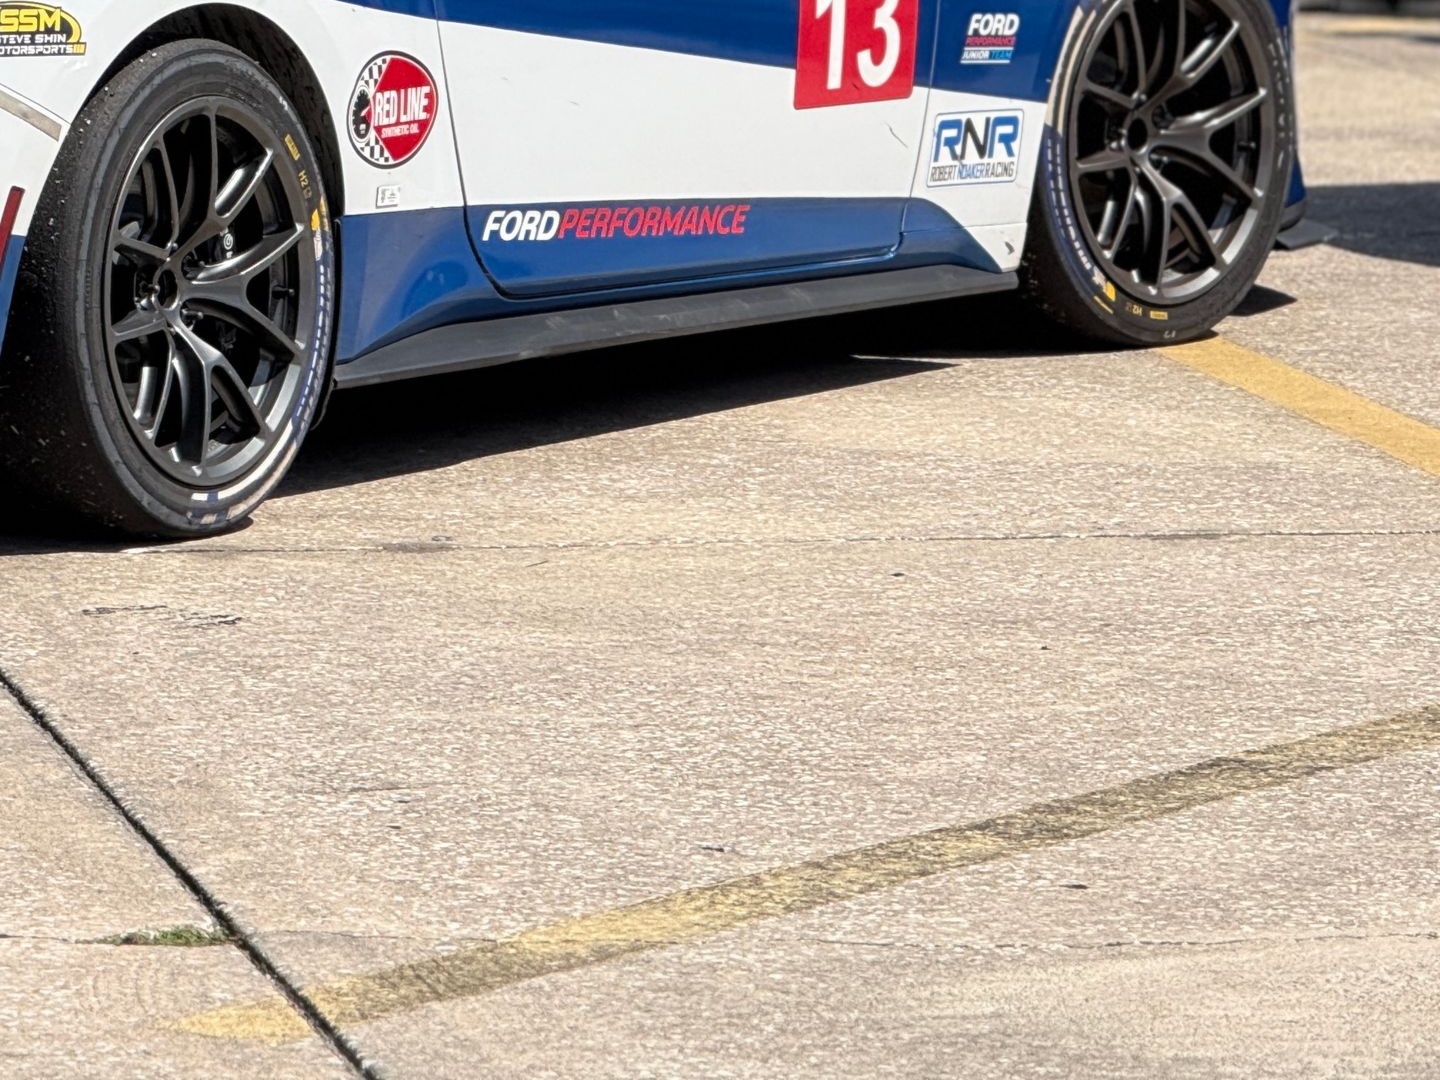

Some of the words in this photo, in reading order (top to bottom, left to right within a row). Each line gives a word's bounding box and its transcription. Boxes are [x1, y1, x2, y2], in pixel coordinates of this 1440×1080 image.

[967, 13, 1020, 36] FORD
[34, 34, 67, 44] SHIN
[962, 50, 990, 60] JUNIOR
[374, 89, 399, 126] RED
[933, 115, 1020, 162] RNR
